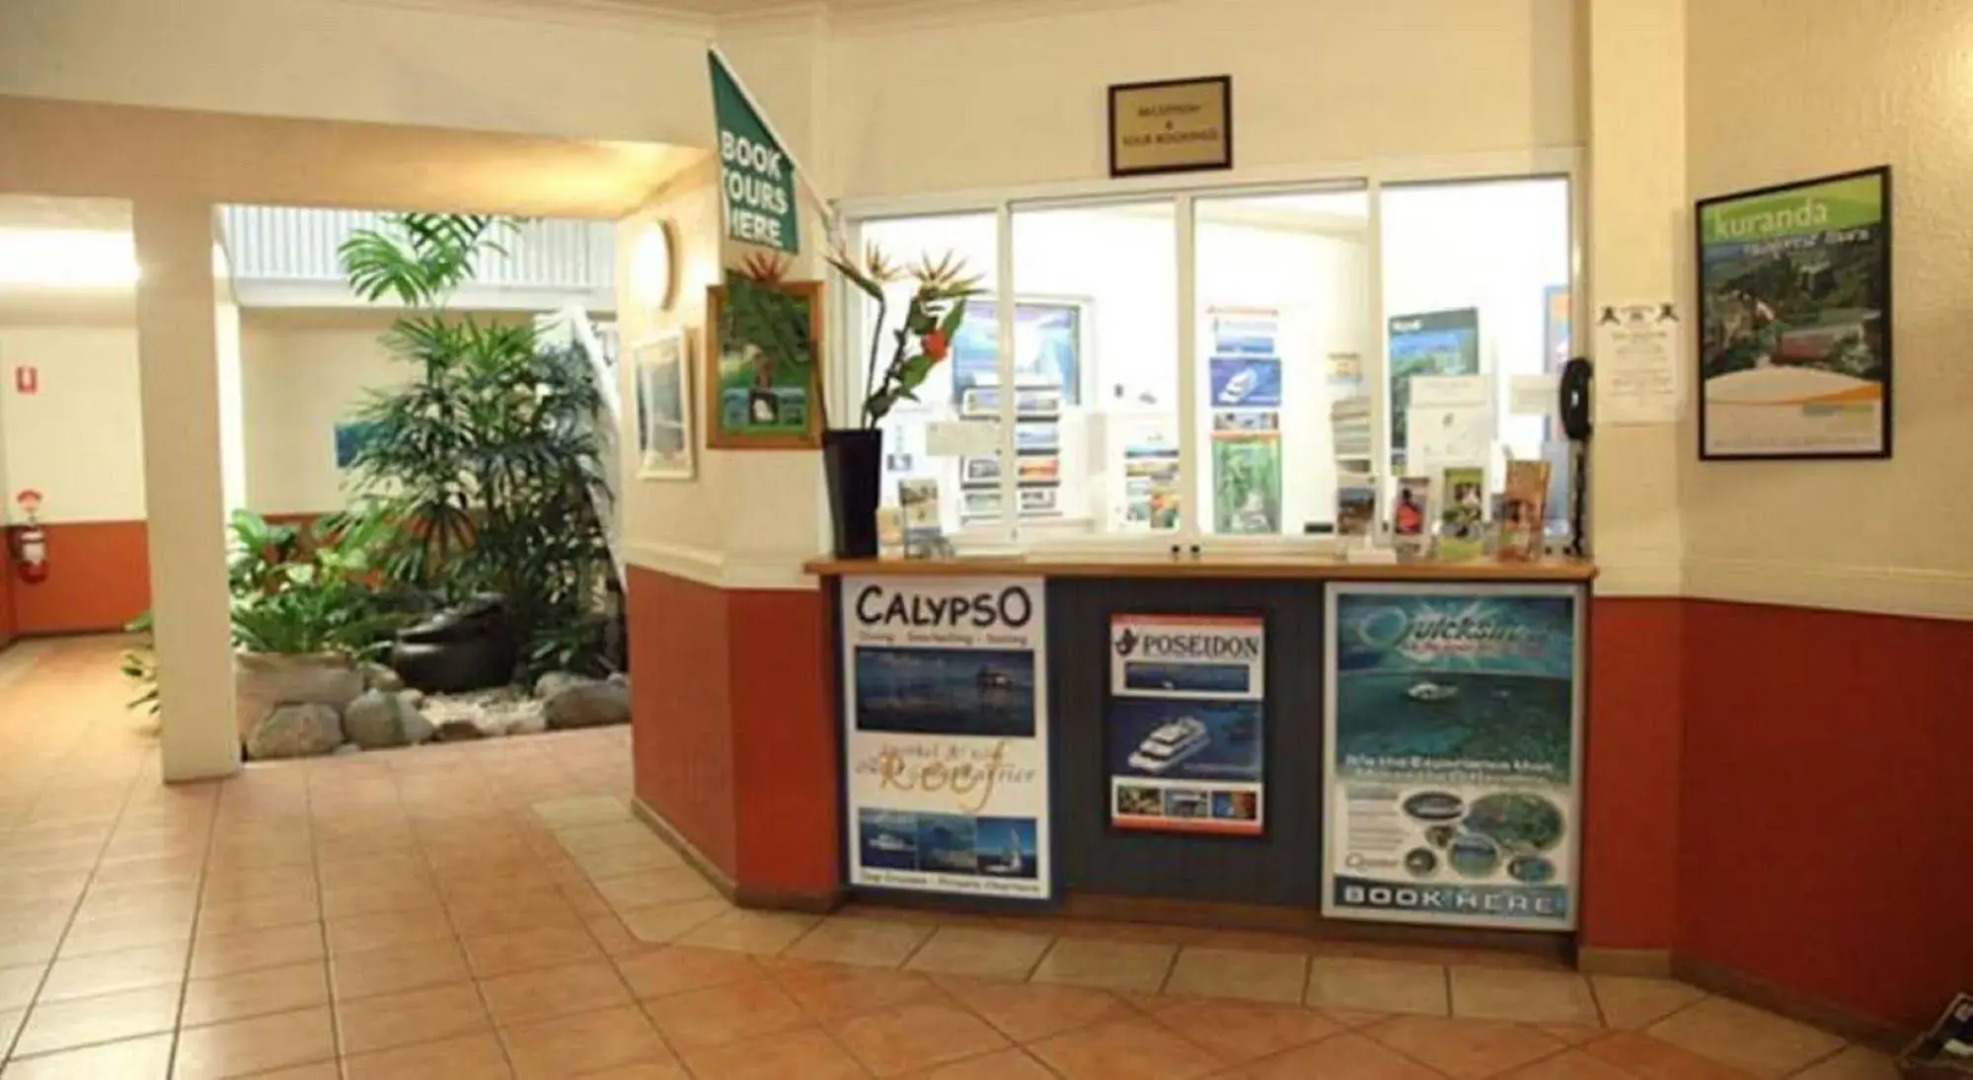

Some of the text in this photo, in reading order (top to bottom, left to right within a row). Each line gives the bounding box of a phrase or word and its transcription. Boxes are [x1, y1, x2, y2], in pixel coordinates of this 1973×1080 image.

[721, 130, 782, 181] BOOK
[1713, 197, 1828, 240] kuranda
[856, 585, 1032, 629] CALYPSO
[1143, 634, 1259, 659] POSEIDON
[879, 739, 1008, 813] Reef
[1344, 885, 1554, 914] BOOK HERE
